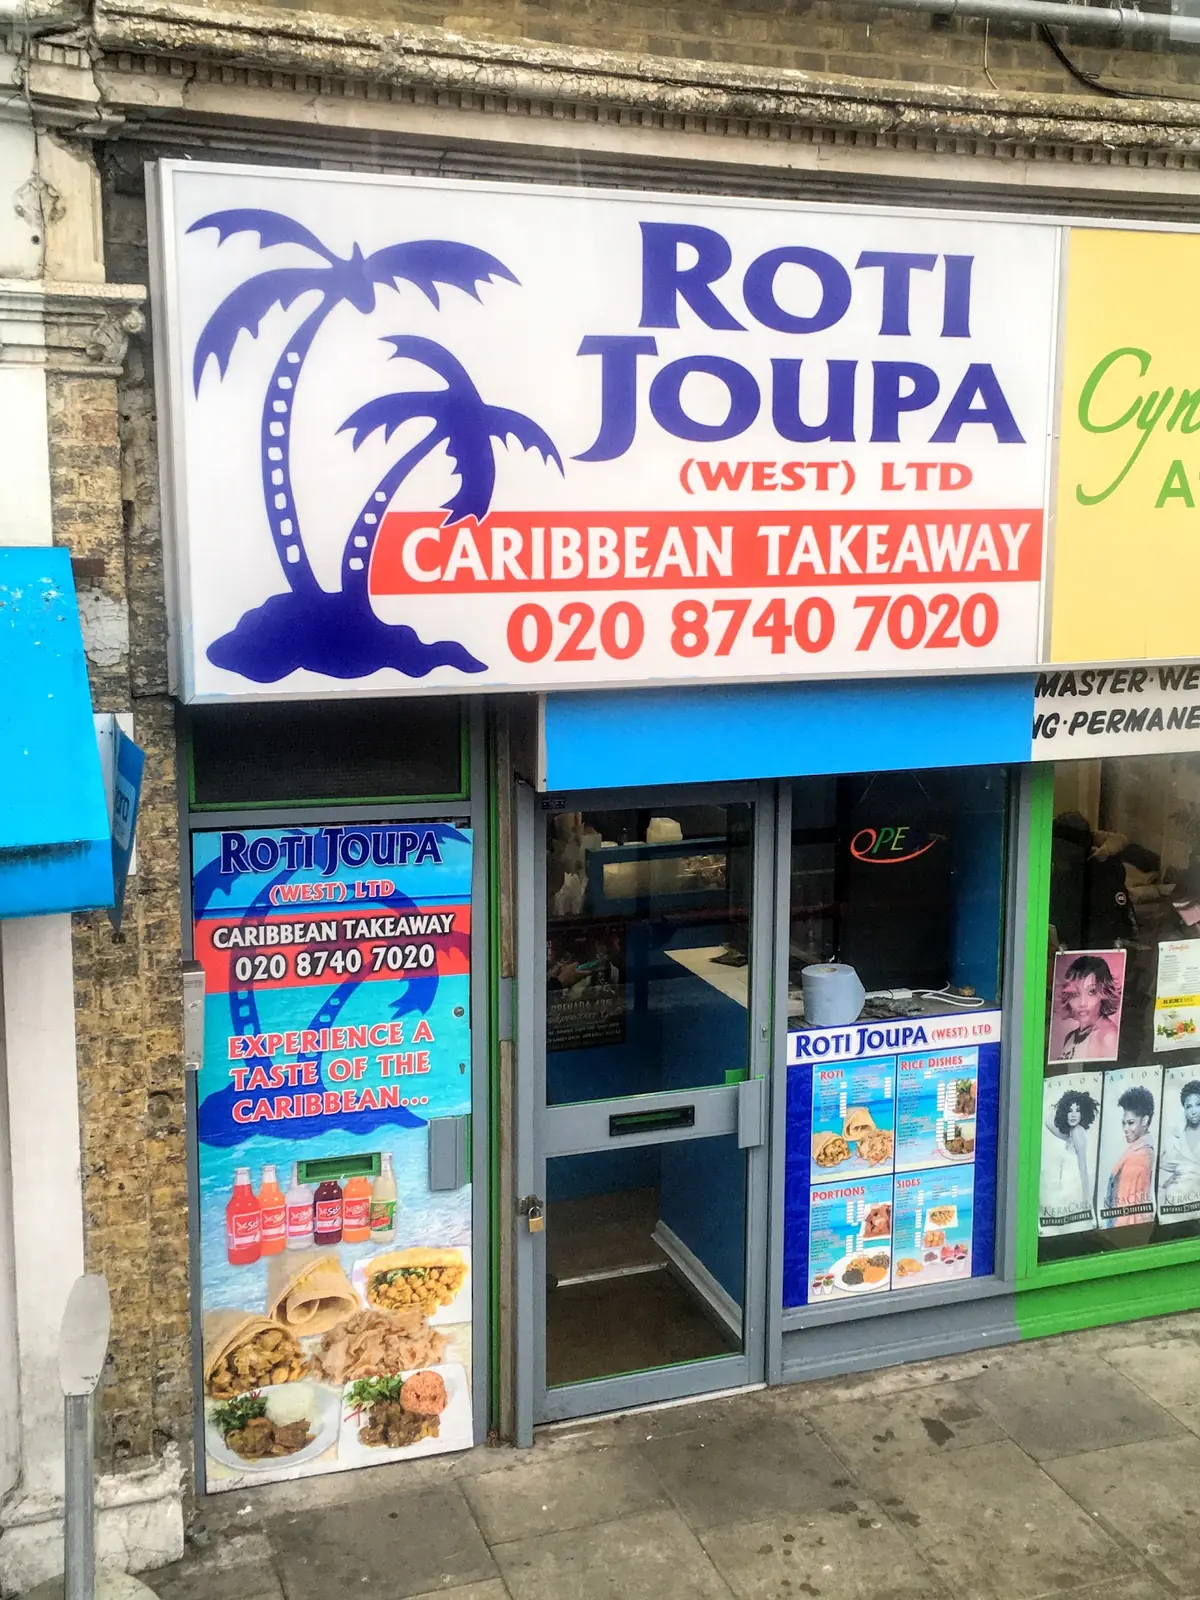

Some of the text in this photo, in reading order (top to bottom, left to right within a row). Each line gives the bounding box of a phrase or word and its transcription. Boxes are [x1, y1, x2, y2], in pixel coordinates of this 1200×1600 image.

[638, 220, 975, 338] ROTI
[569, 334, 1027, 463] JOUPA
[679, 458, 973, 497] (WEST) LTD
[1154, 459, 1200, 509] A
[401, 522, 1032, 584] CARIBBEAN TAKEAWAY
[506, 591, 999, 663] 020 8740 7020
[219, 828, 442, 876] ROTI JOUPA
[268, 879, 396, 906] (WEST) LTD
[212, 913, 455, 950] CARIBBEAN TAKEAWAY
[234, 943, 436, 982] 020 8740 7020
[227, 1019, 435, 1061] EXPERIENCE A
[795, 1022, 992, 1058] ROTI JOUPA (WEST) LTD
[229, 1049, 431, 1093] TASTE OF THE
[820, 1069, 844, 1081] ROTI
[901, 1060, 924, 1071] RICE
[928, 1056, 963, 1068] DISHES
[812, 1186, 866, 1201] PORTIONS
[896, 1178, 921, 1189] SIDES
